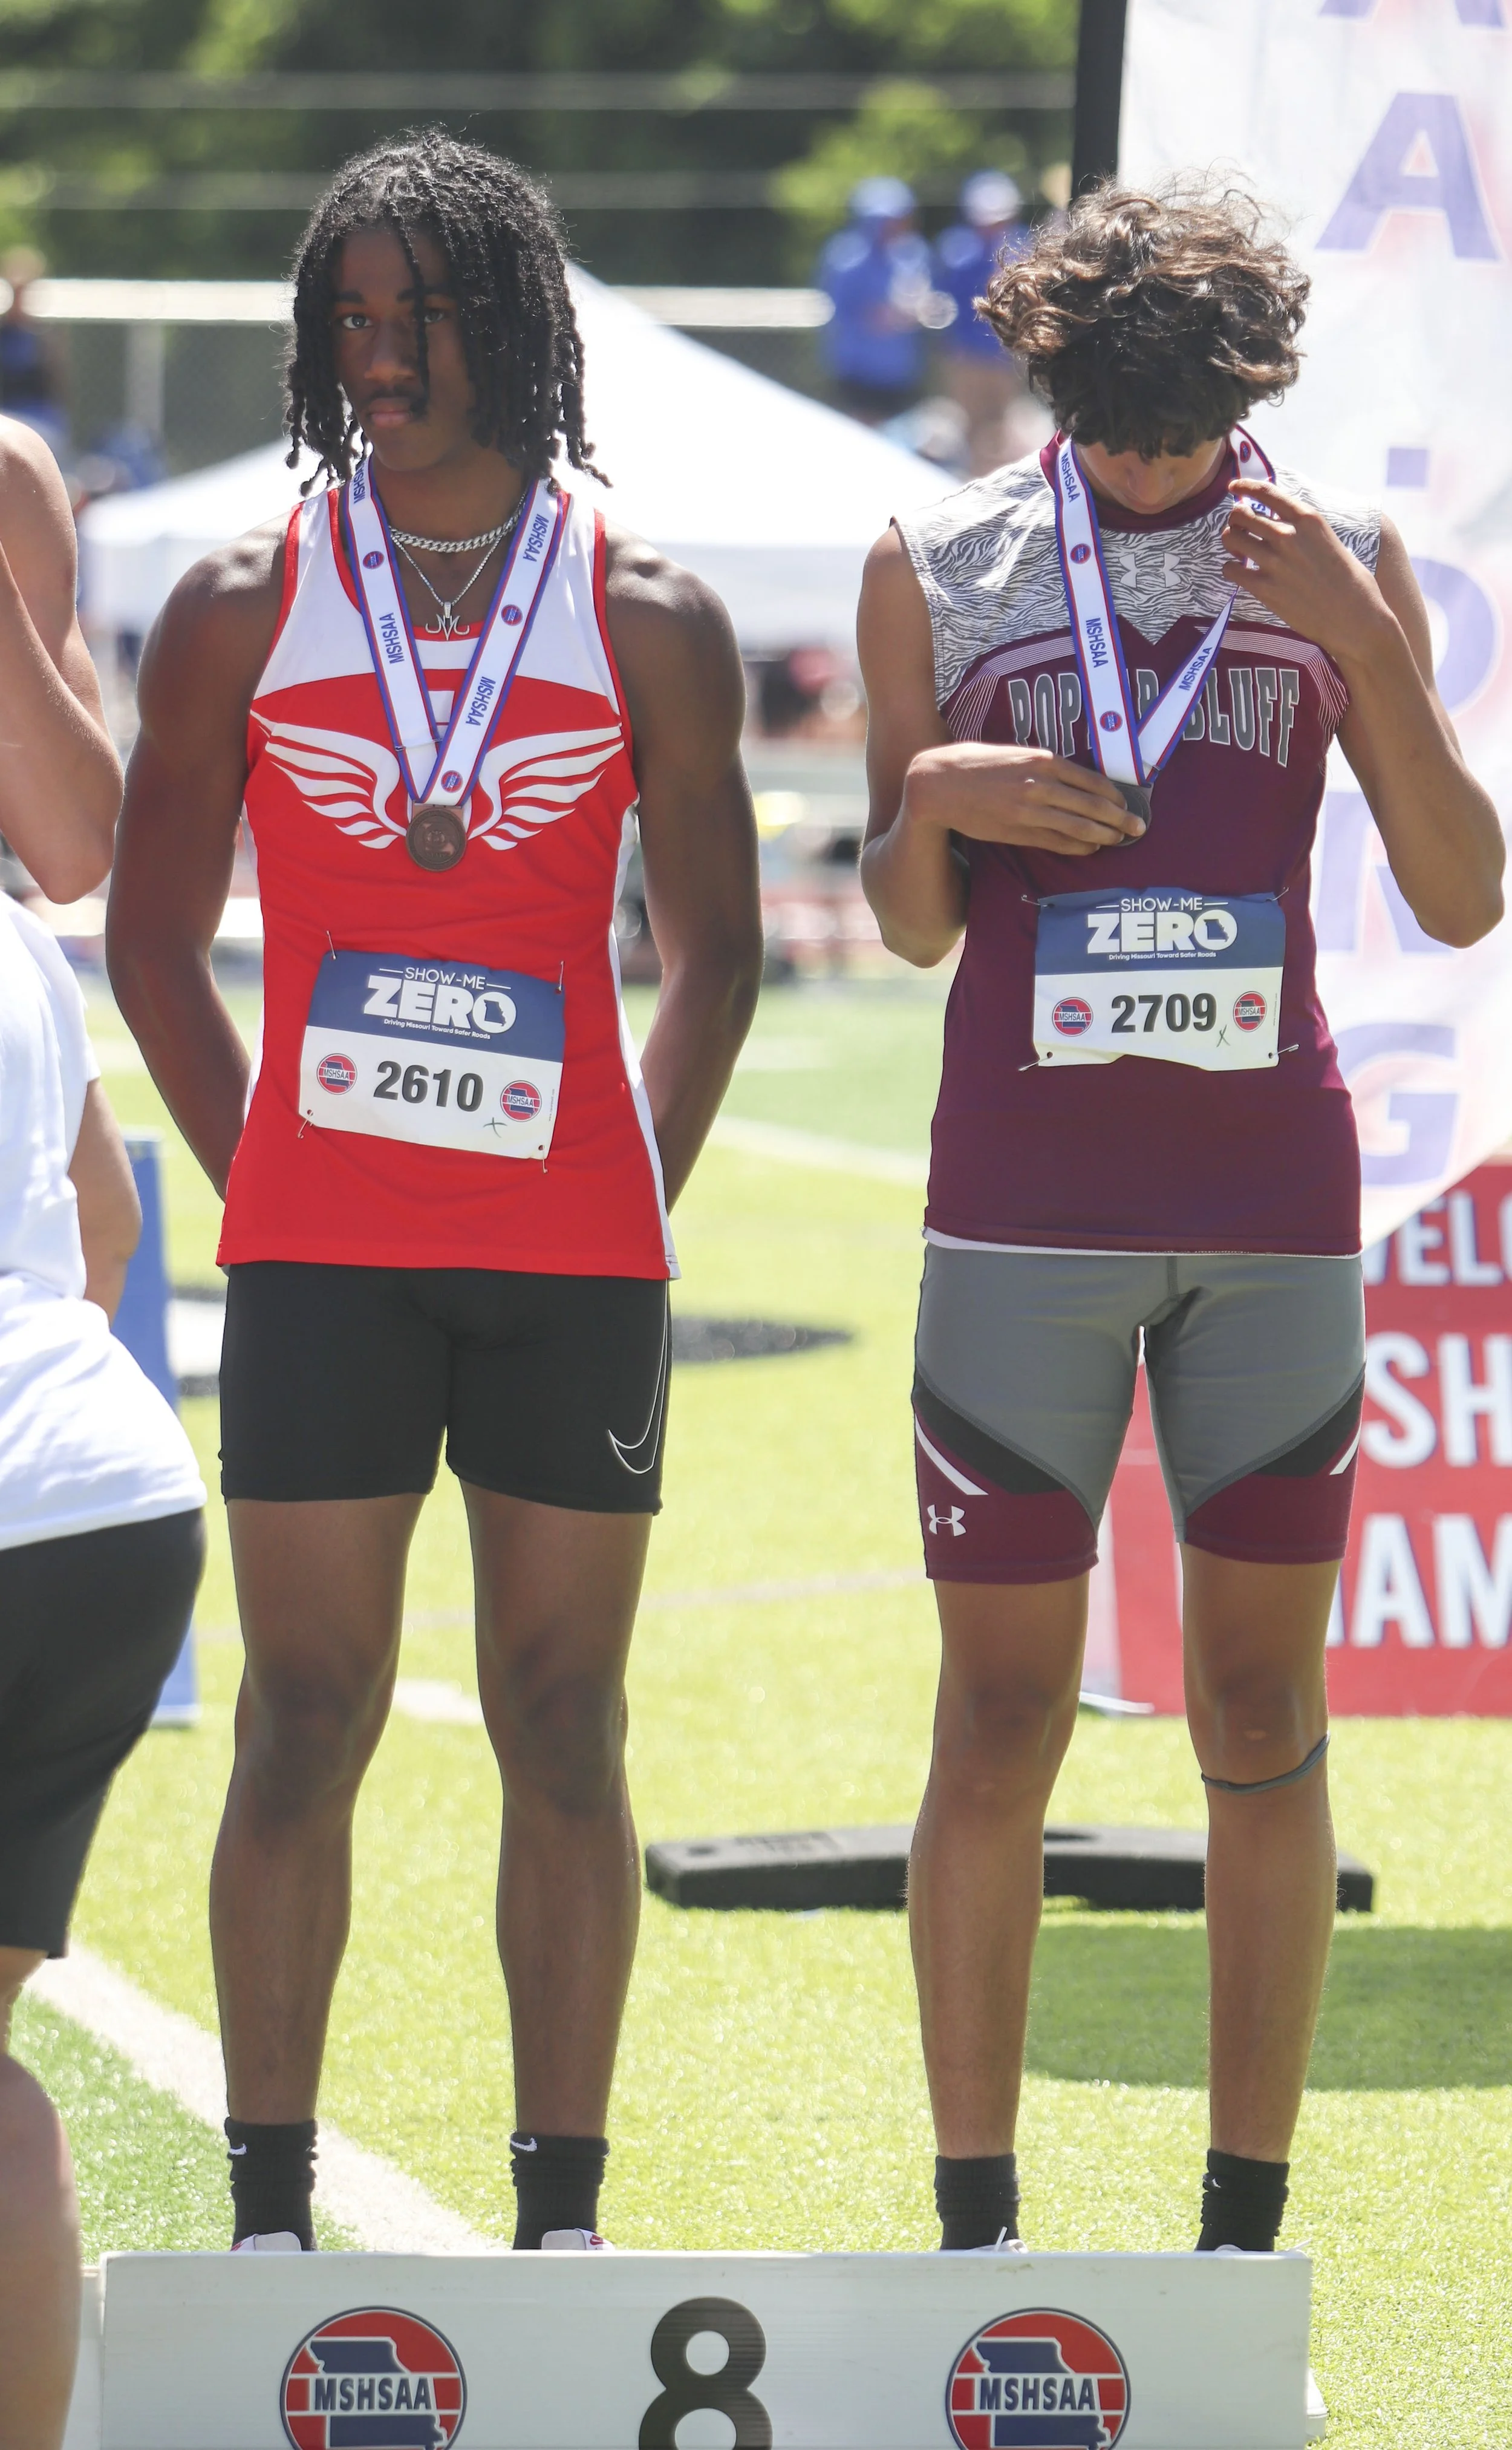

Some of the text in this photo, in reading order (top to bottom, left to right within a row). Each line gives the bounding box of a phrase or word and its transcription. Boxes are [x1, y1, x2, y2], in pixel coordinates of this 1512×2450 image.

[1061, 452, 1080, 503] MSHSAA
[523, 514, 549, 562] MSHSAA
[379, 612, 405, 664] MSHSAA
[1086, 617, 1109, 668] MSHSAA
[1178, 647, 1213, 691] MSHSAA
[466, 676, 496, 726] MSHSAA
[1121, 897, 1203, 912] SHOW-ME
[1087, 909, 1238, 953] ZERO
[405, 967, 485, 990] SHOW-ME
[363, 975, 516, 1033] ZERO
[1059, 1012, 1086, 1021] MSHSAA
[1111, 993, 1217, 1034] 2709
[383, 1018, 405, 1028] Driving
[406, 1021, 430, 1030] Missouri
[431, 1025, 454, 1034] Toward
[454, 1028, 471, 1037] Safer
[324, 1068, 349, 1080] MSHSAA
[373, 1060, 484, 1112] 2610
[507, 1095, 533, 1107] MSHSAA
[1326, 1512, 1512, 1649] AM
[314, 2377, 432, 2411] MSHSAA
[639, 2296, 773, 2450] 8
[979, 2377, 1097, 2411] MSHSAA
